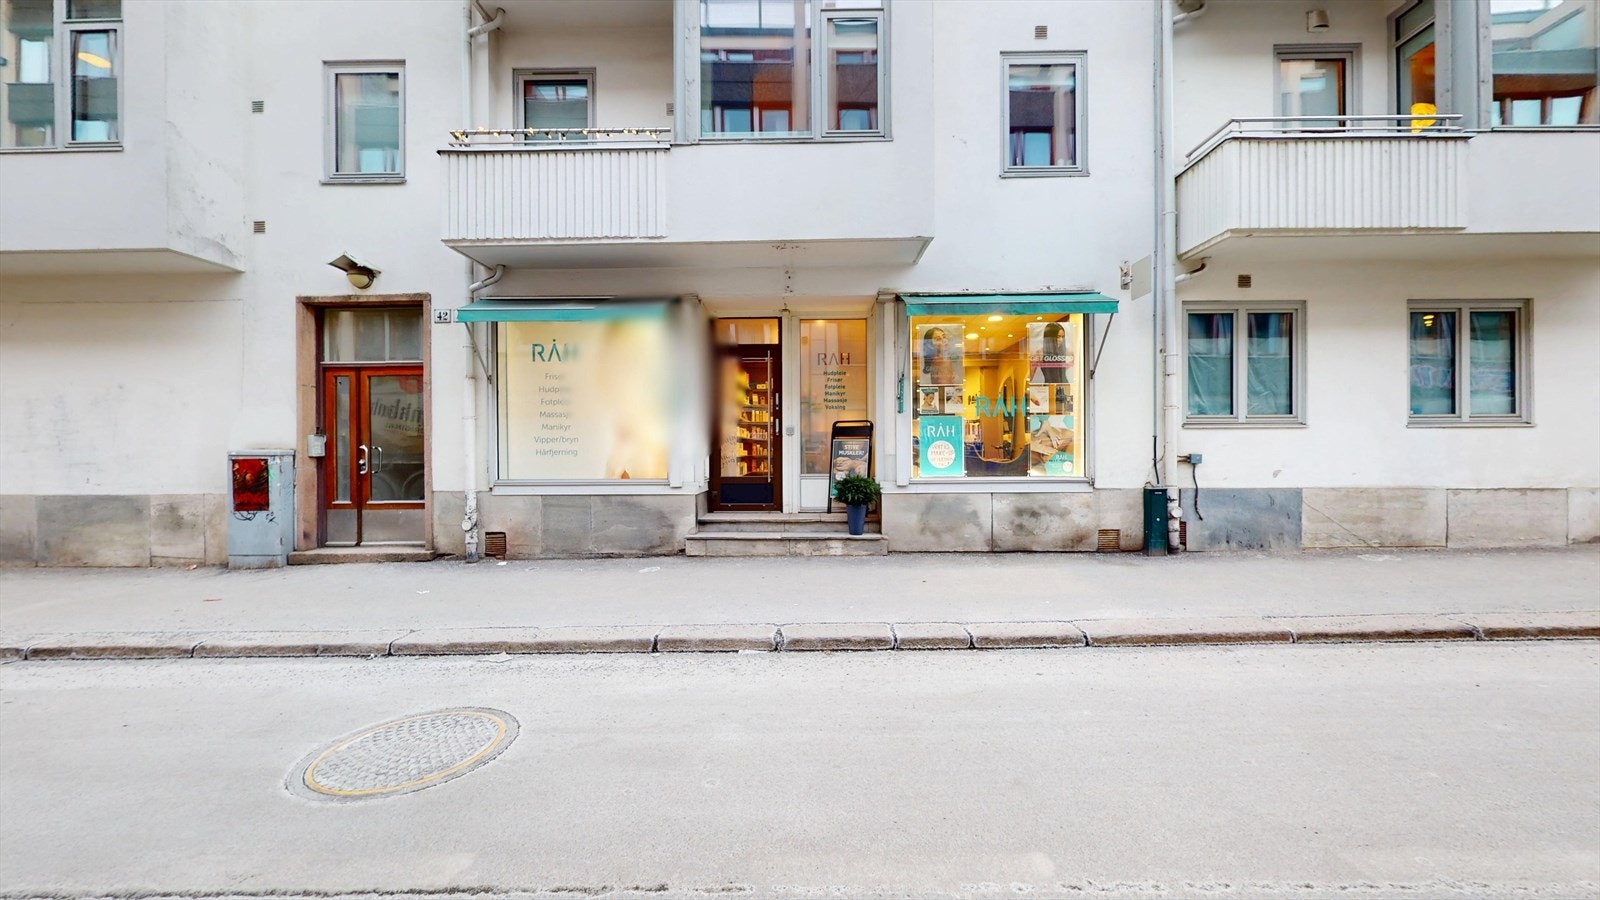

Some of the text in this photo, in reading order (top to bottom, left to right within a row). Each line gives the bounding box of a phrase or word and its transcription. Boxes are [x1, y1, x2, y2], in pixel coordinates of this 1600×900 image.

[437, 311, 448, 321] 42
[539, 411, 572, 419] Massasj
[541, 423, 571, 432] Manikyr
[927, 422, 955, 437] RÅH
[533, 436, 579, 445] Vipper/bryn
[535, 448, 578, 458] Hårfjerning
